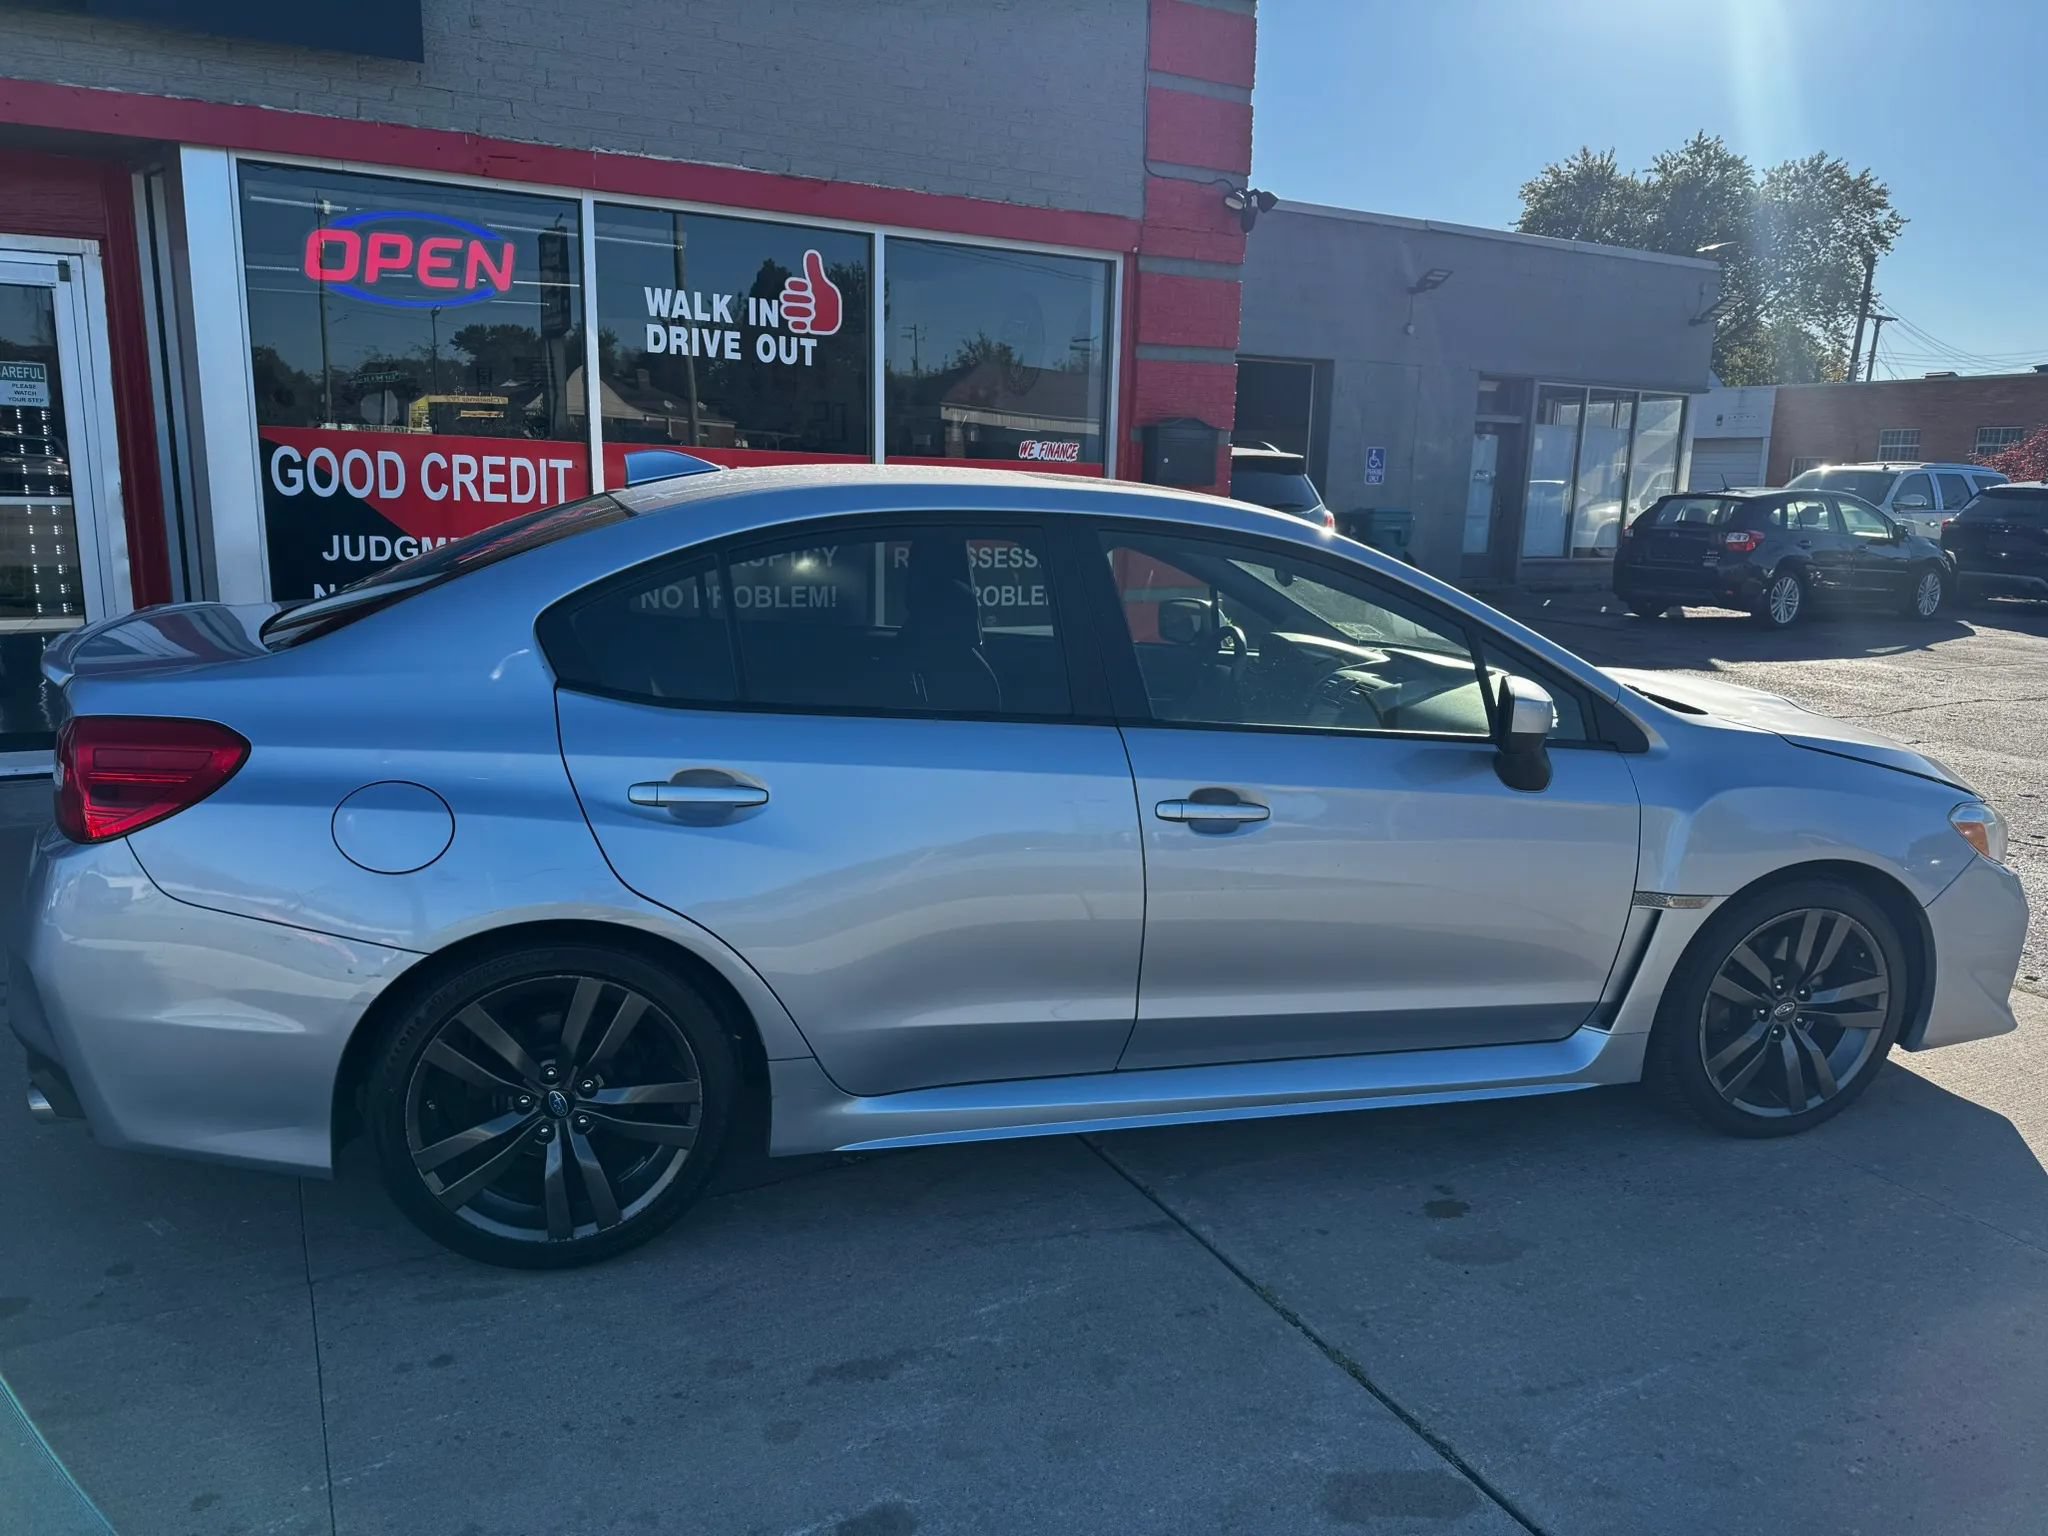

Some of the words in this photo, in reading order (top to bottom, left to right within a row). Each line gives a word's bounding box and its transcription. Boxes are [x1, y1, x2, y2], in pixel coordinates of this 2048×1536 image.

[304, 228, 515, 292] OPEN
[644, 286, 733, 324] WALK
[748, 296, 779, 328] IN
[646, 323, 742, 360] DRIVE
[756, 333, 818, 366] OUT
[0, 366, 44, 379] AREFUL
[1019, 440, 1037, 459] WE
[1038, 441, 1080, 461] FINANCE
[270, 445, 406, 499] GOOD
[420, 452, 573, 505] CREDIT
[640, 584, 684, 609] NO
